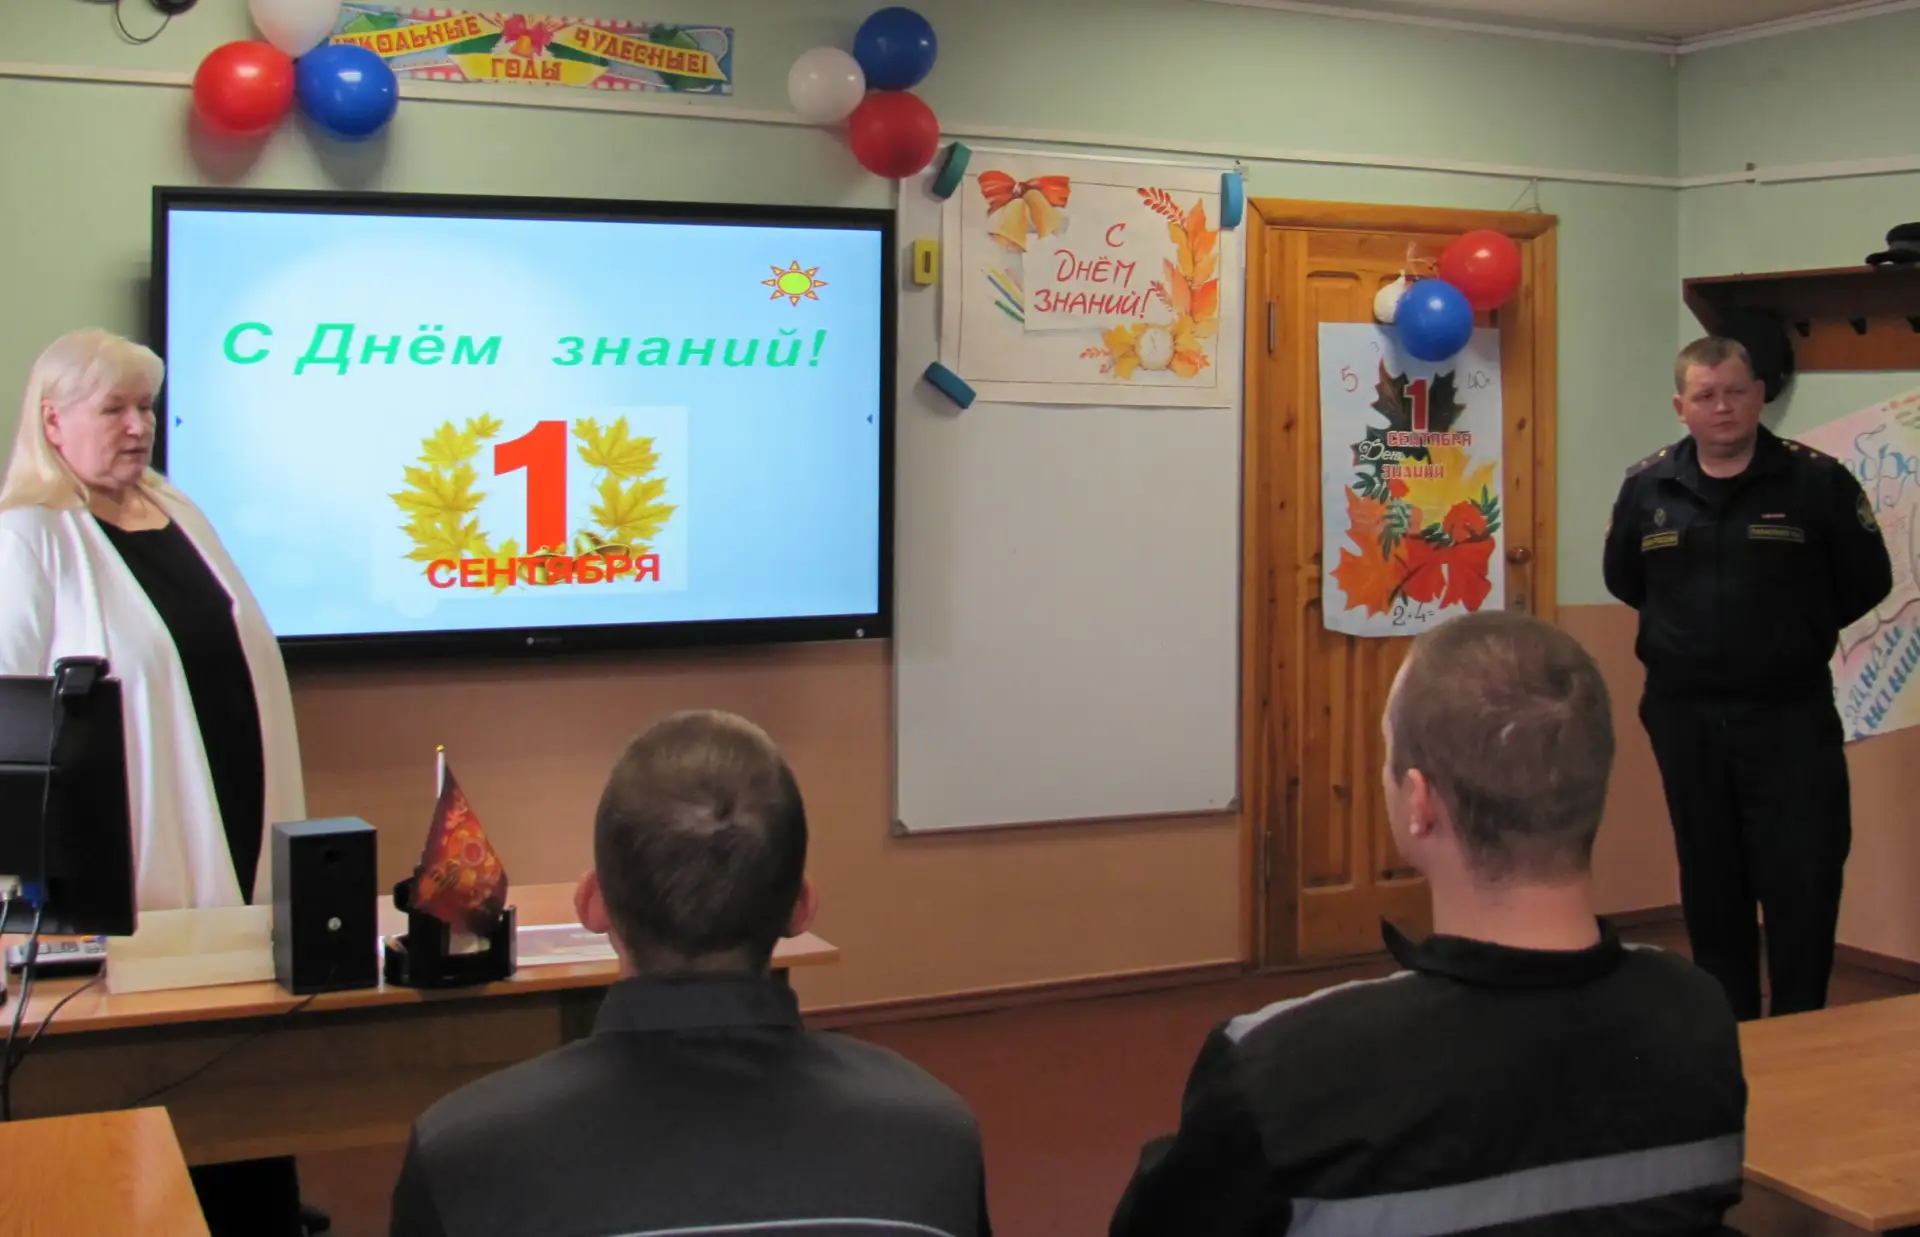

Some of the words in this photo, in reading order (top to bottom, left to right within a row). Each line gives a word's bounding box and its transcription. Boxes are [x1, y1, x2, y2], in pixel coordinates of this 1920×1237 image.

[573, 27, 708, 74] ЧУДЕСНЫЕ!
[491, 58, 560, 81] ГОДЫ
[1033, 287, 1152, 319] ЗНАНИЙ!
[222, 321, 272, 364] С
[294, 323, 502, 375] Днём
[552, 329, 827, 367] знаний!
[1341, 364, 1359, 392] 5
[1404, 378, 1429, 431] 1
[1386, 431, 1473, 447] СЕНТЯБРЯ
[495, 421, 568, 553] 1
[427, 553, 661, 588] СЕНТЯБРЯ
